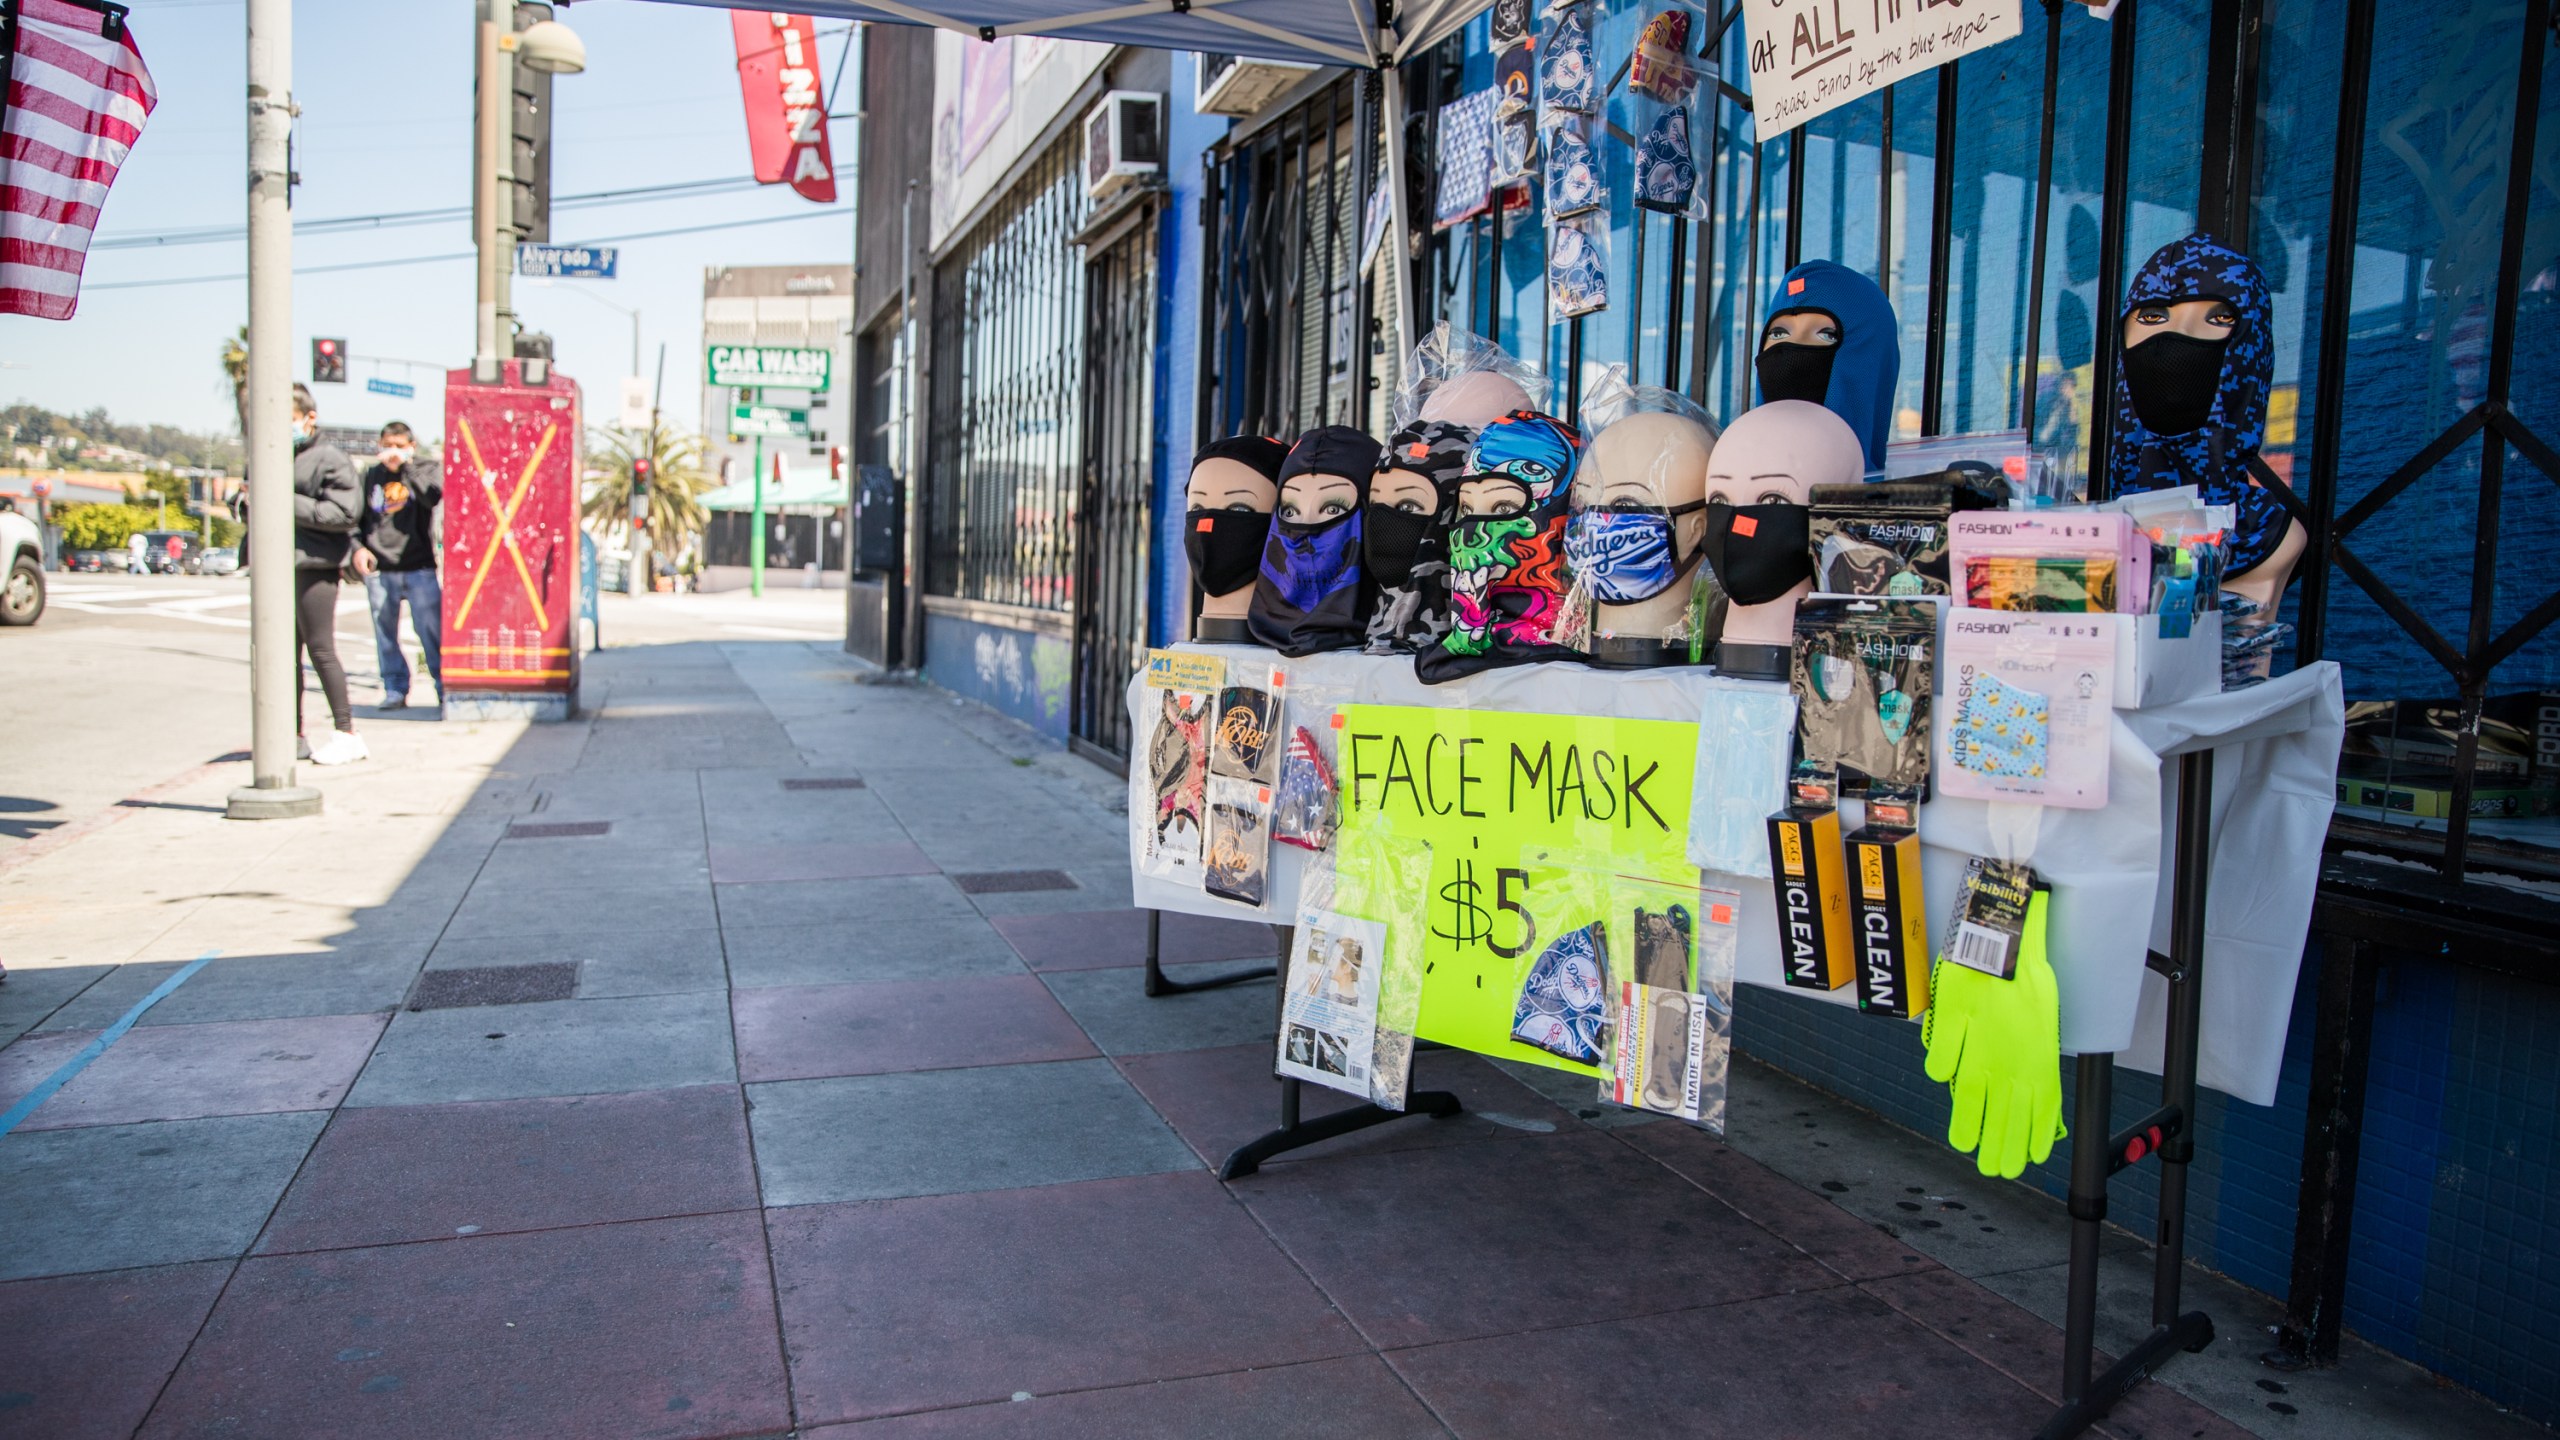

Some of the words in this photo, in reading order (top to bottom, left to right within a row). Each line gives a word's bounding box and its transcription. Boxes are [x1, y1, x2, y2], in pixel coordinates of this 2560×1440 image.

[1752, 30, 1777, 74] at
[1791, 6, 1856, 65] ALL
[1774, 92, 1809, 131] please
[1858, 57, 1877, 85] by
[1878, 46, 1903, 73] the
[1909, 32, 1936, 61] blue
[771, 13, 830, 183] IZZA
[521, 245, 591, 267] Alvarado
[712, 347, 761, 373] CAR
[761, 348, 828, 377] WASH
[1869, 525, 1934, 542] FASHION
[1958, 522, 2012, 535] FASHION
[1891, 580, 1920, 596] mask
[1957, 622, 2010, 634] FASHION
[1855, 642, 1923, 661] FASHION
[1883, 702, 1910, 714] mask
[1959, 664, 1974, 724] MASKS
[1215, 715, 1270, 750] KOBE
[1953, 728, 1969, 768] KIDS
[1352, 733, 1486, 818] FACE
[1509, 740, 1671, 832] MASK
[1967, 876, 2027, 907] Visibility
[1431, 858, 1537, 959] $5
[1786, 888, 1816, 979] CLEAN
[1864, 913, 1894, 1007] CLEAN
[1692, 1010, 1703, 1040] USA
[1616, 1056, 1626, 1079] Mask
[1690, 1046, 1700, 1060] IN
[1687, 1062, 1699, 1103] MADE
